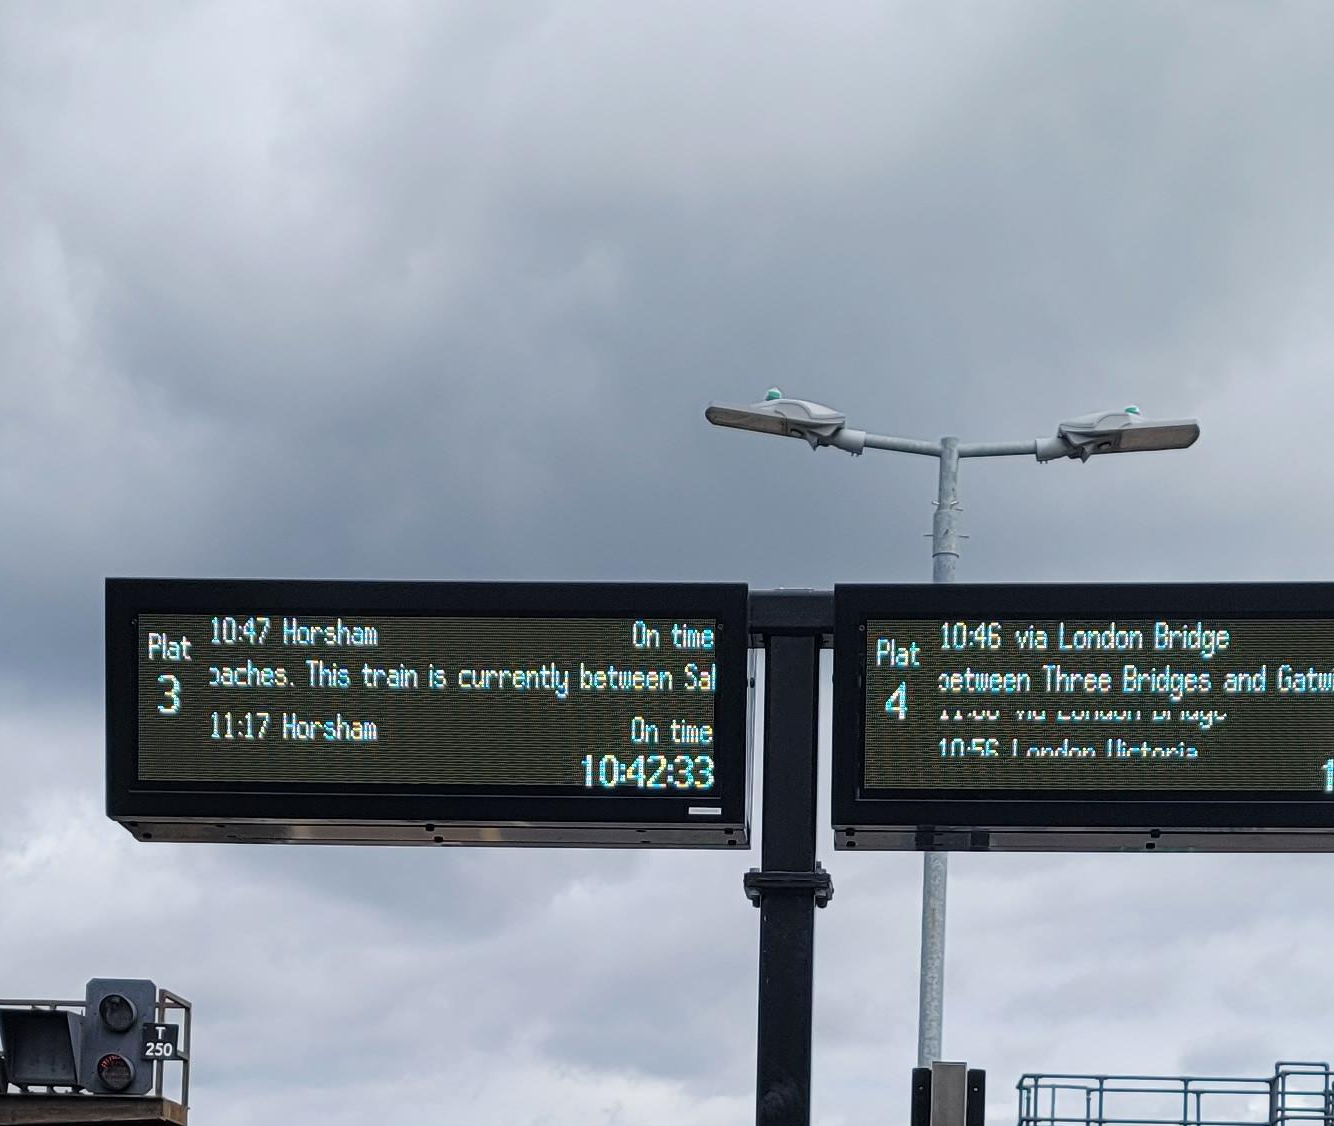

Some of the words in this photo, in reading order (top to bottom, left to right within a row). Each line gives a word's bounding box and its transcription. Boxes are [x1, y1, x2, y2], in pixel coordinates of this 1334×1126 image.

[148, 632, 191, 661] Plat
[210, 616, 270, 645] 10:47
[283, 617, 378, 646] Horsham
[632, 620, 659, 648] On
[672, 623, 714, 648] time
[940, 622, 1001, 649] 10:46
[1015, 624, 1048, 649] via
[1058, 622, 1143, 649] London
[1154, 622, 1229, 658] Bridge
[877, 638, 920, 666] Plat
[157, 674, 181, 713] 3
[305, 659, 350, 688] This
[362, 663, 417, 688] train
[429, 663, 447, 688] is
[459, 662, 568, 699] currently
[580, 662, 672, 690] between
[1042, 664, 1112, 692] Three
[1123, 664, 1211, 701] Bridges
[1224, 665, 1266, 692] and
[885, 681, 908, 720] 4
[210, 711, 269, 740] 11:17
[282, 712, 378, 741] Horsham
[631, 716, 659, 744] On
[670, 719, 713, 743] time
[581, 754, 715, 788] 10:42:33
[145, 1042, 173, 1057] 250
[155, 1026, 166, 1040] T
